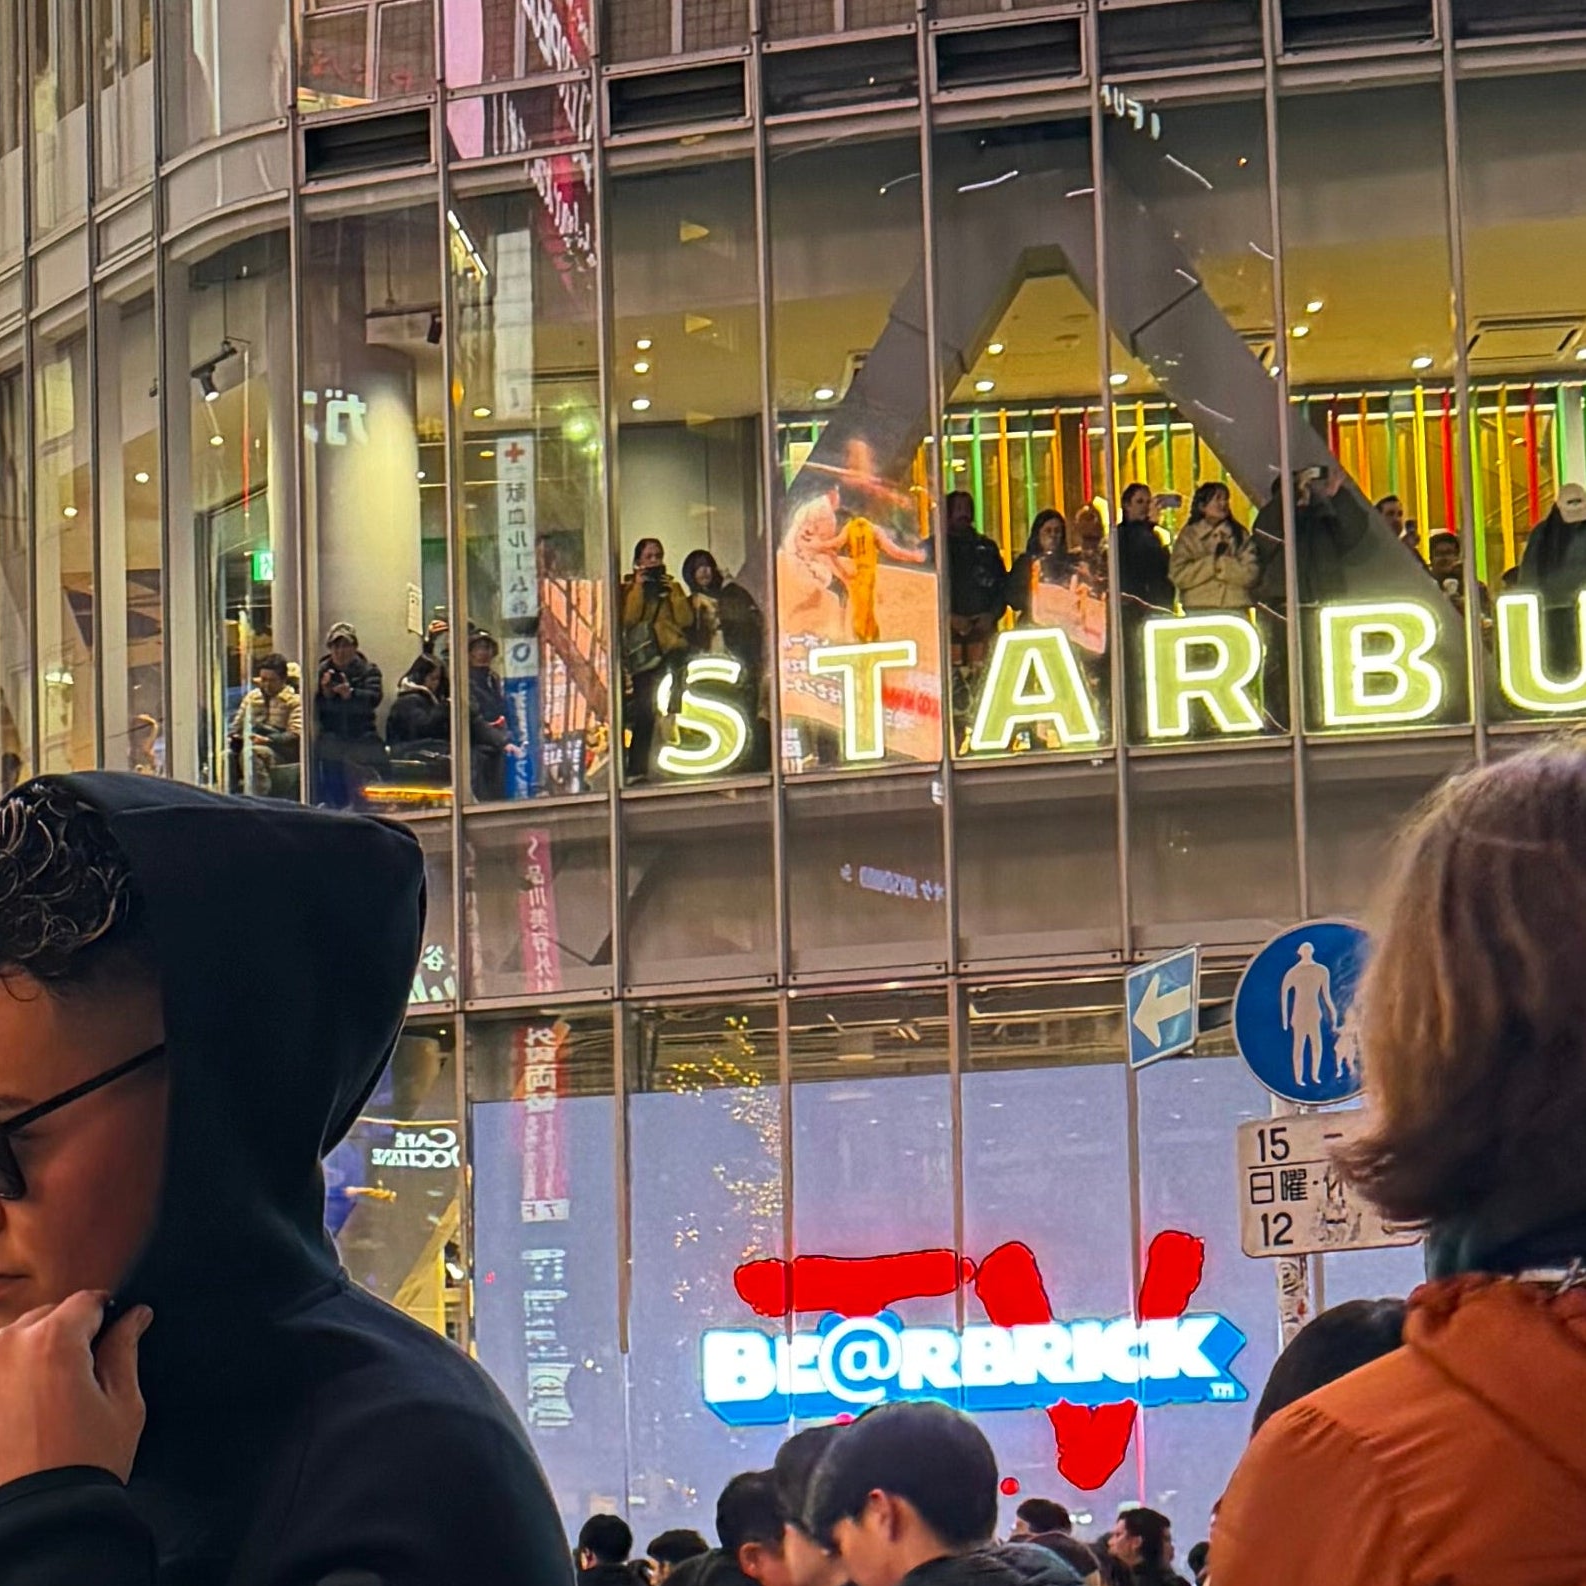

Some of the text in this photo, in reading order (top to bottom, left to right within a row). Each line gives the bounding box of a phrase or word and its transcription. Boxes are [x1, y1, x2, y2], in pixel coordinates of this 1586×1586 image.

[656, 588, 1586, 776] STARBU
[1257, 1127, 1290, 1162] 15
[1260, 1211, 1294, 1247] 12
[702, 1314, 1225, 1403] BE@RBRICK
